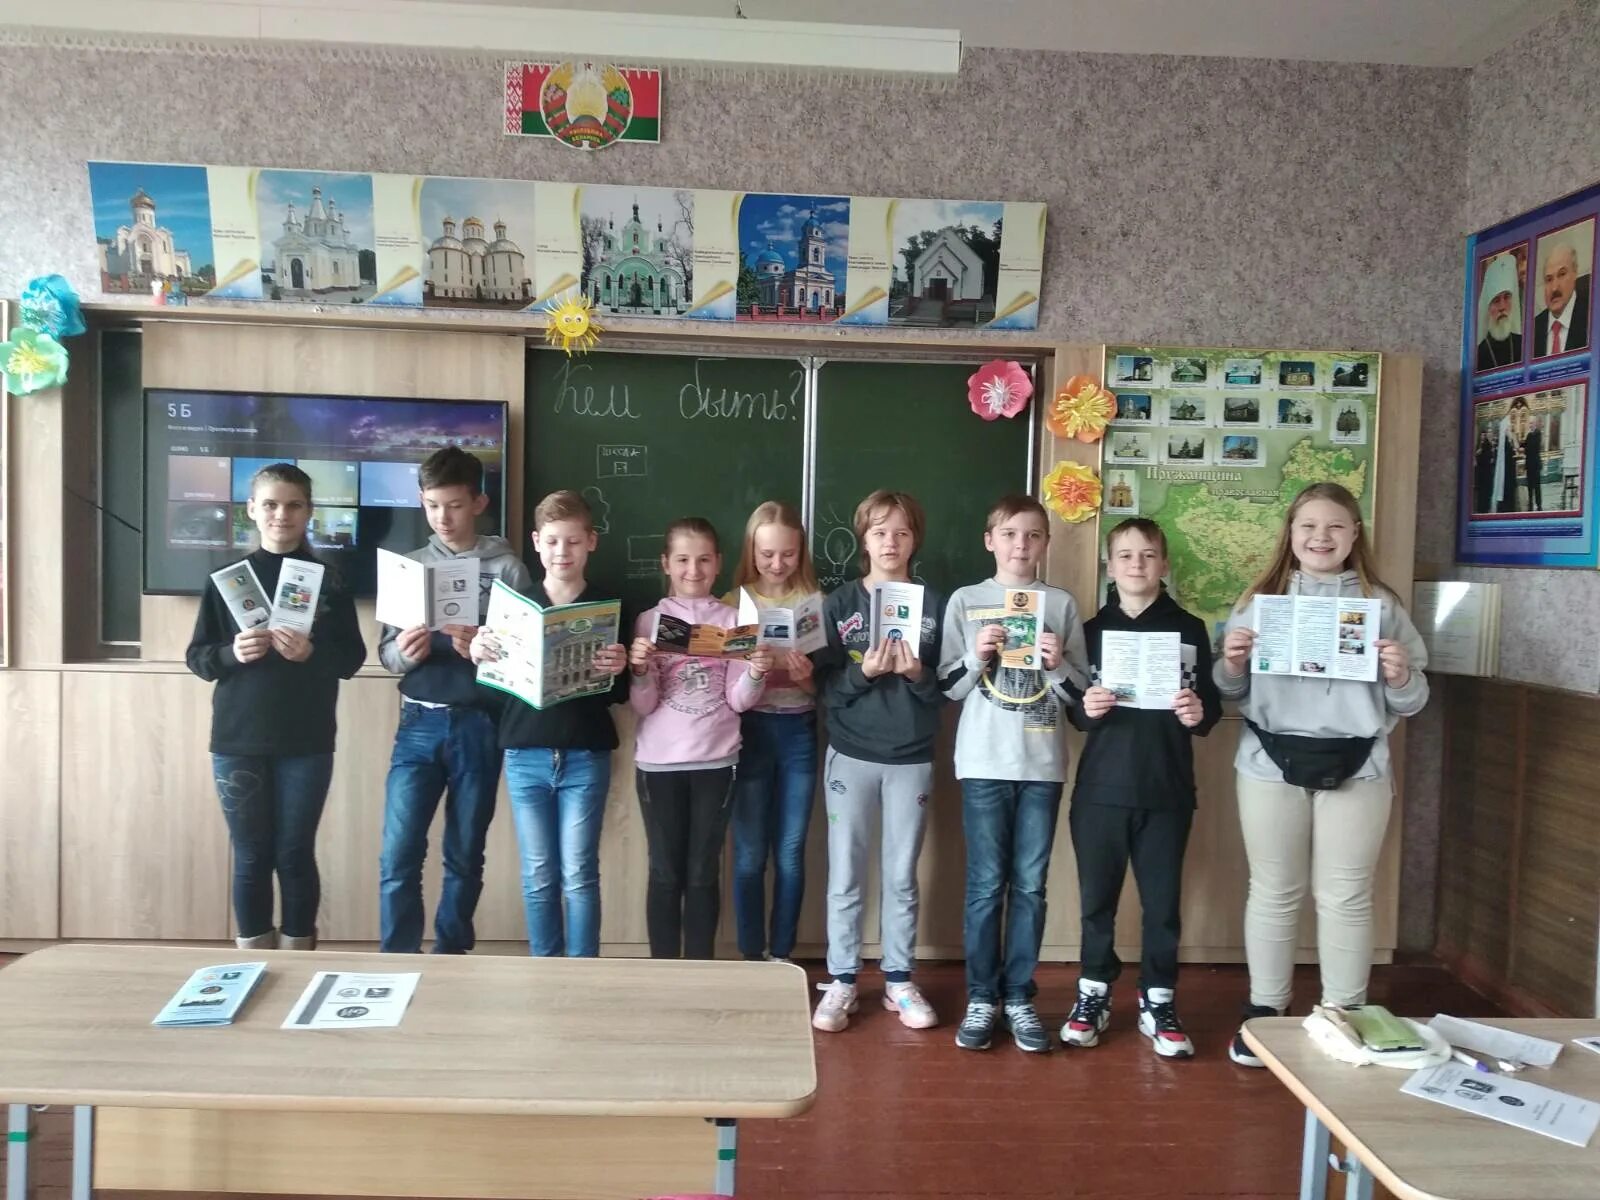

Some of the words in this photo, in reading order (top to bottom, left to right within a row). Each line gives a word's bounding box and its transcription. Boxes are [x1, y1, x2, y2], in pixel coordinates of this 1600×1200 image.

[680, 358, 803, 421] быть?
[168, 403, 177, 417] 5
[180, 403, 192, 418] Б
[1146, 466, 1242, 483] Пружанщина
